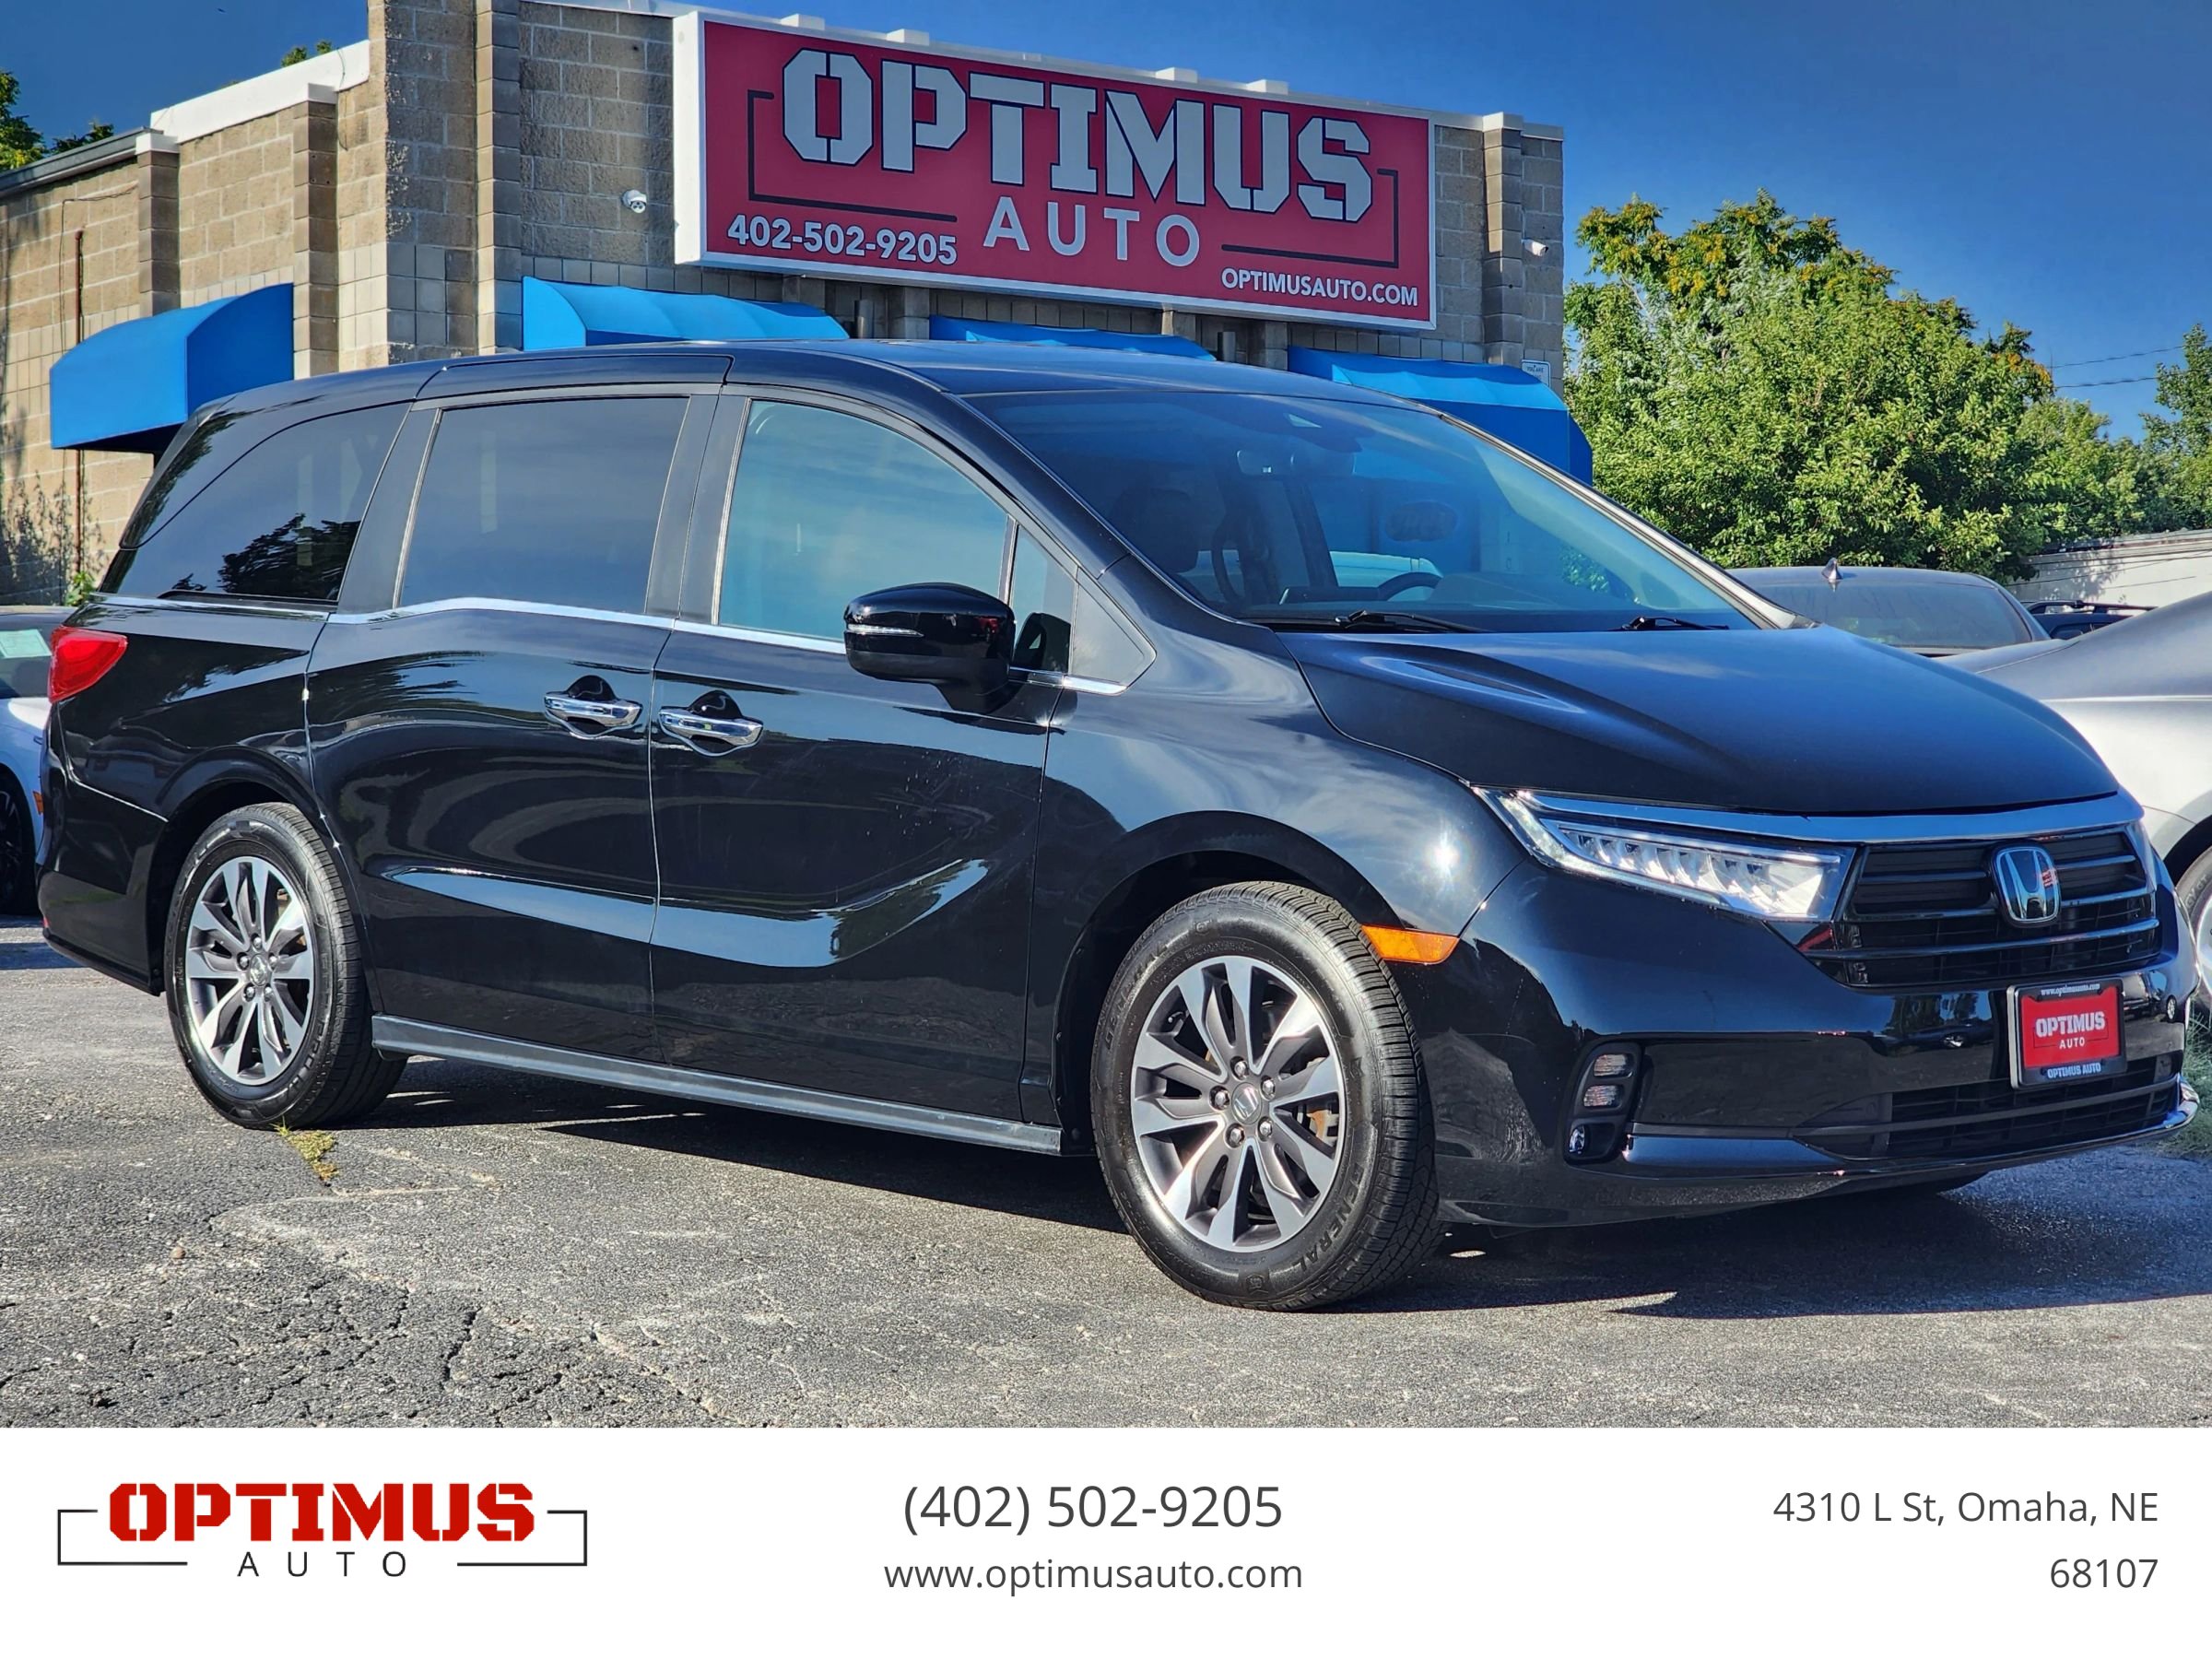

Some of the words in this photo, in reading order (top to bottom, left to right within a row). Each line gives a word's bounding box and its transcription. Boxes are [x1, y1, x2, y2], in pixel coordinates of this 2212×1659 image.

[782, 48, 1372, 223] OPTIMUS
[727, 214, 958, 265] 402-502-9205
[982, 196, 1201, 267] AUTO
[1221, 267, 1418, 307] OPTIMUSAUTO.COM
[2035, 1011, 2105, 1038] OPTIMUS
[2059, 1036, 2086, 1050] AUTO
[2046, 1065, 2081, 1079] OPTIMUS
[2081, 1062, 2102, 1076] AUTO
